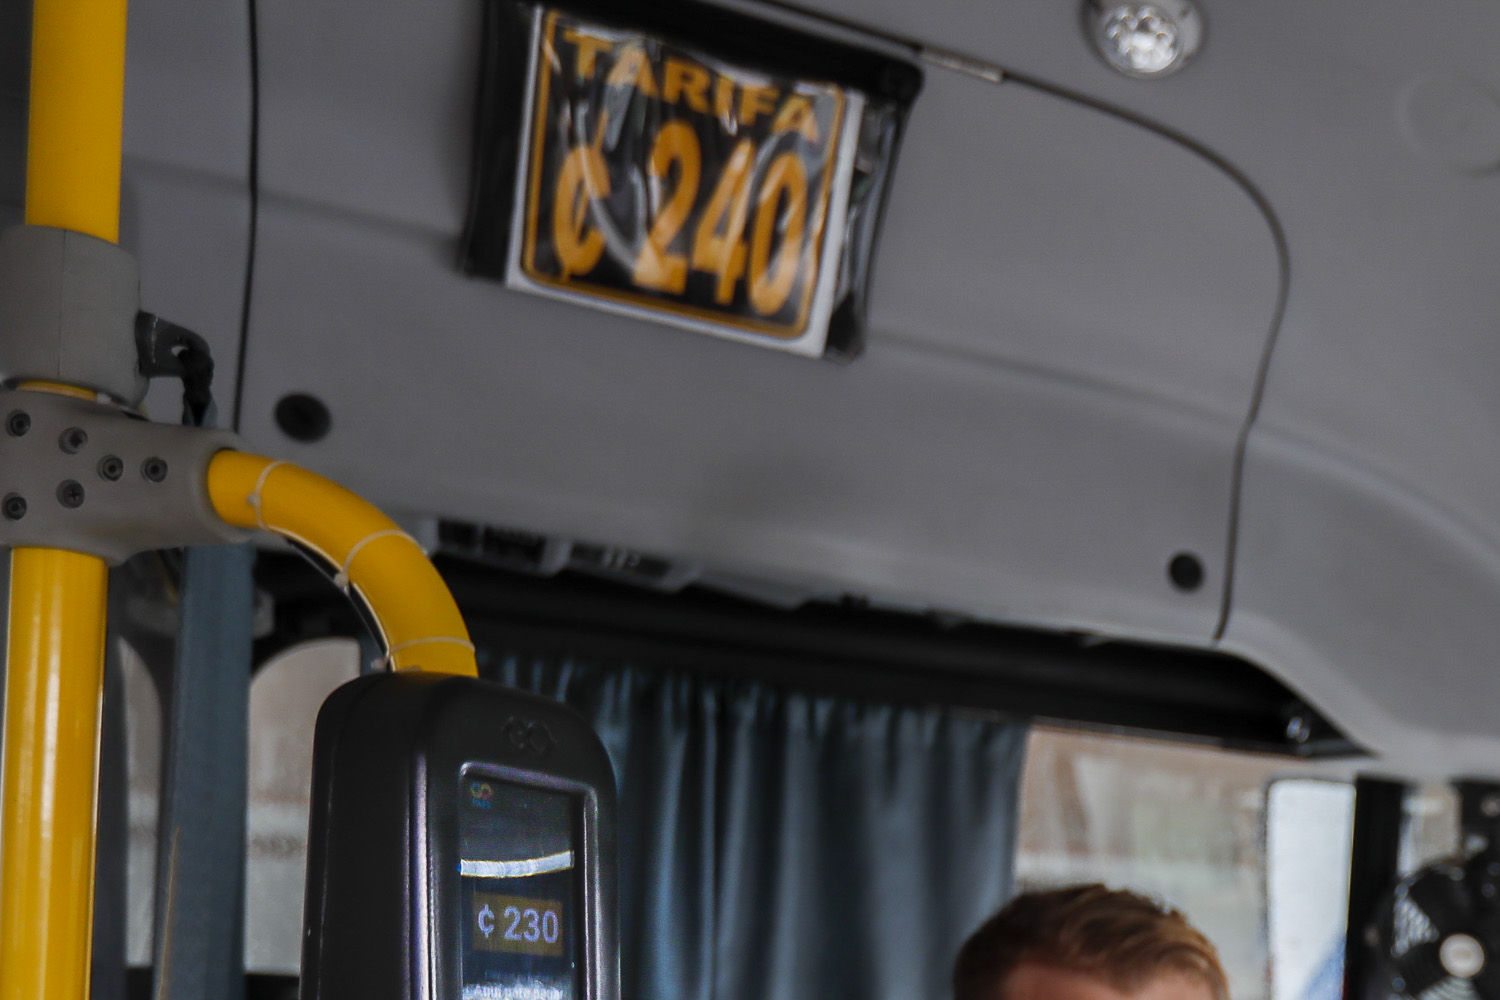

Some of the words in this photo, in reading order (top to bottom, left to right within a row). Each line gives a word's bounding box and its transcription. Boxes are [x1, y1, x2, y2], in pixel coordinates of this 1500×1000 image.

[564, 30, 819, 141] TARIFA
[633, 119, 808, 315] 240
[504, 906, 559, 943] 230
